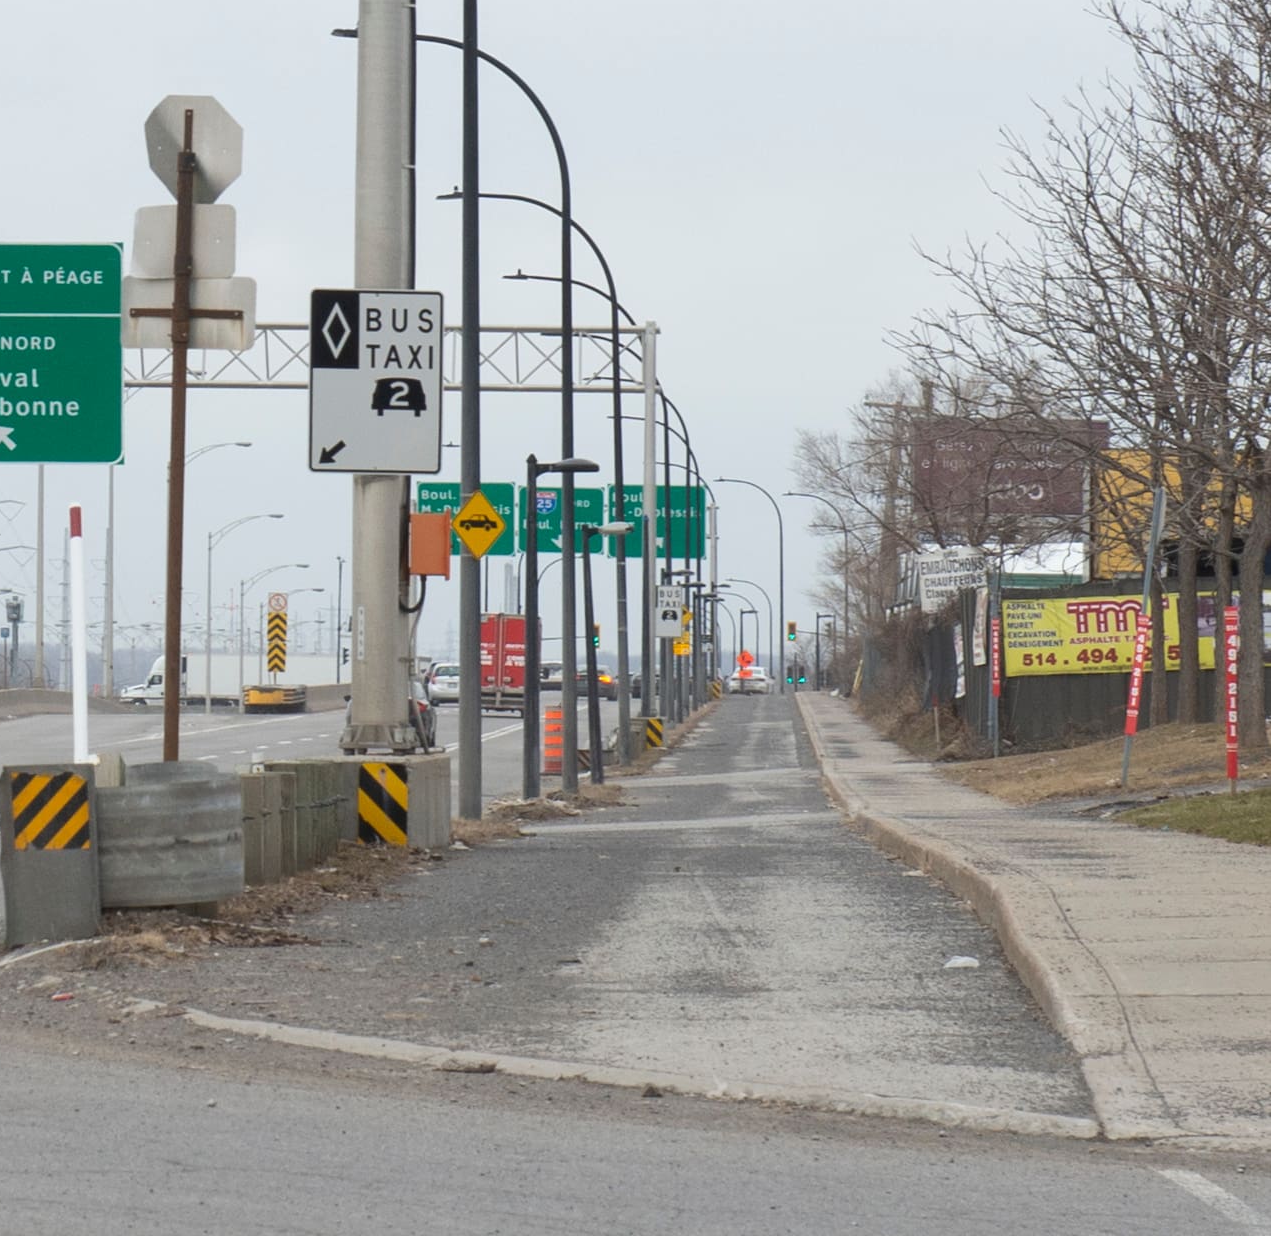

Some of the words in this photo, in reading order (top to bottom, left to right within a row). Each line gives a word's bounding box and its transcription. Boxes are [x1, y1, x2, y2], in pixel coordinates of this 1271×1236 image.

[21, 266, 33, 283] À
[44, 266, 104, 284] PÉAGE
[366, 307, 434, 334] BUS
[0, 336, 56, 350] NORD
[366, 344, 434, 370] TAXI
[389, 383, 410, 405] 2
[421, 489, 457, 501] Boul.
[537, 500, 553, 509] 25
[659, 590, 681, 598] BUS
[659, 600, 681, 608] TAXI
[1008, 631, 1057, 640] EXCAVATION
[1069, 636, 1120, 645] ASPHALTE
[1023, 653, 1057, 667] 514
[1077, 648, 1118, 664] 494
